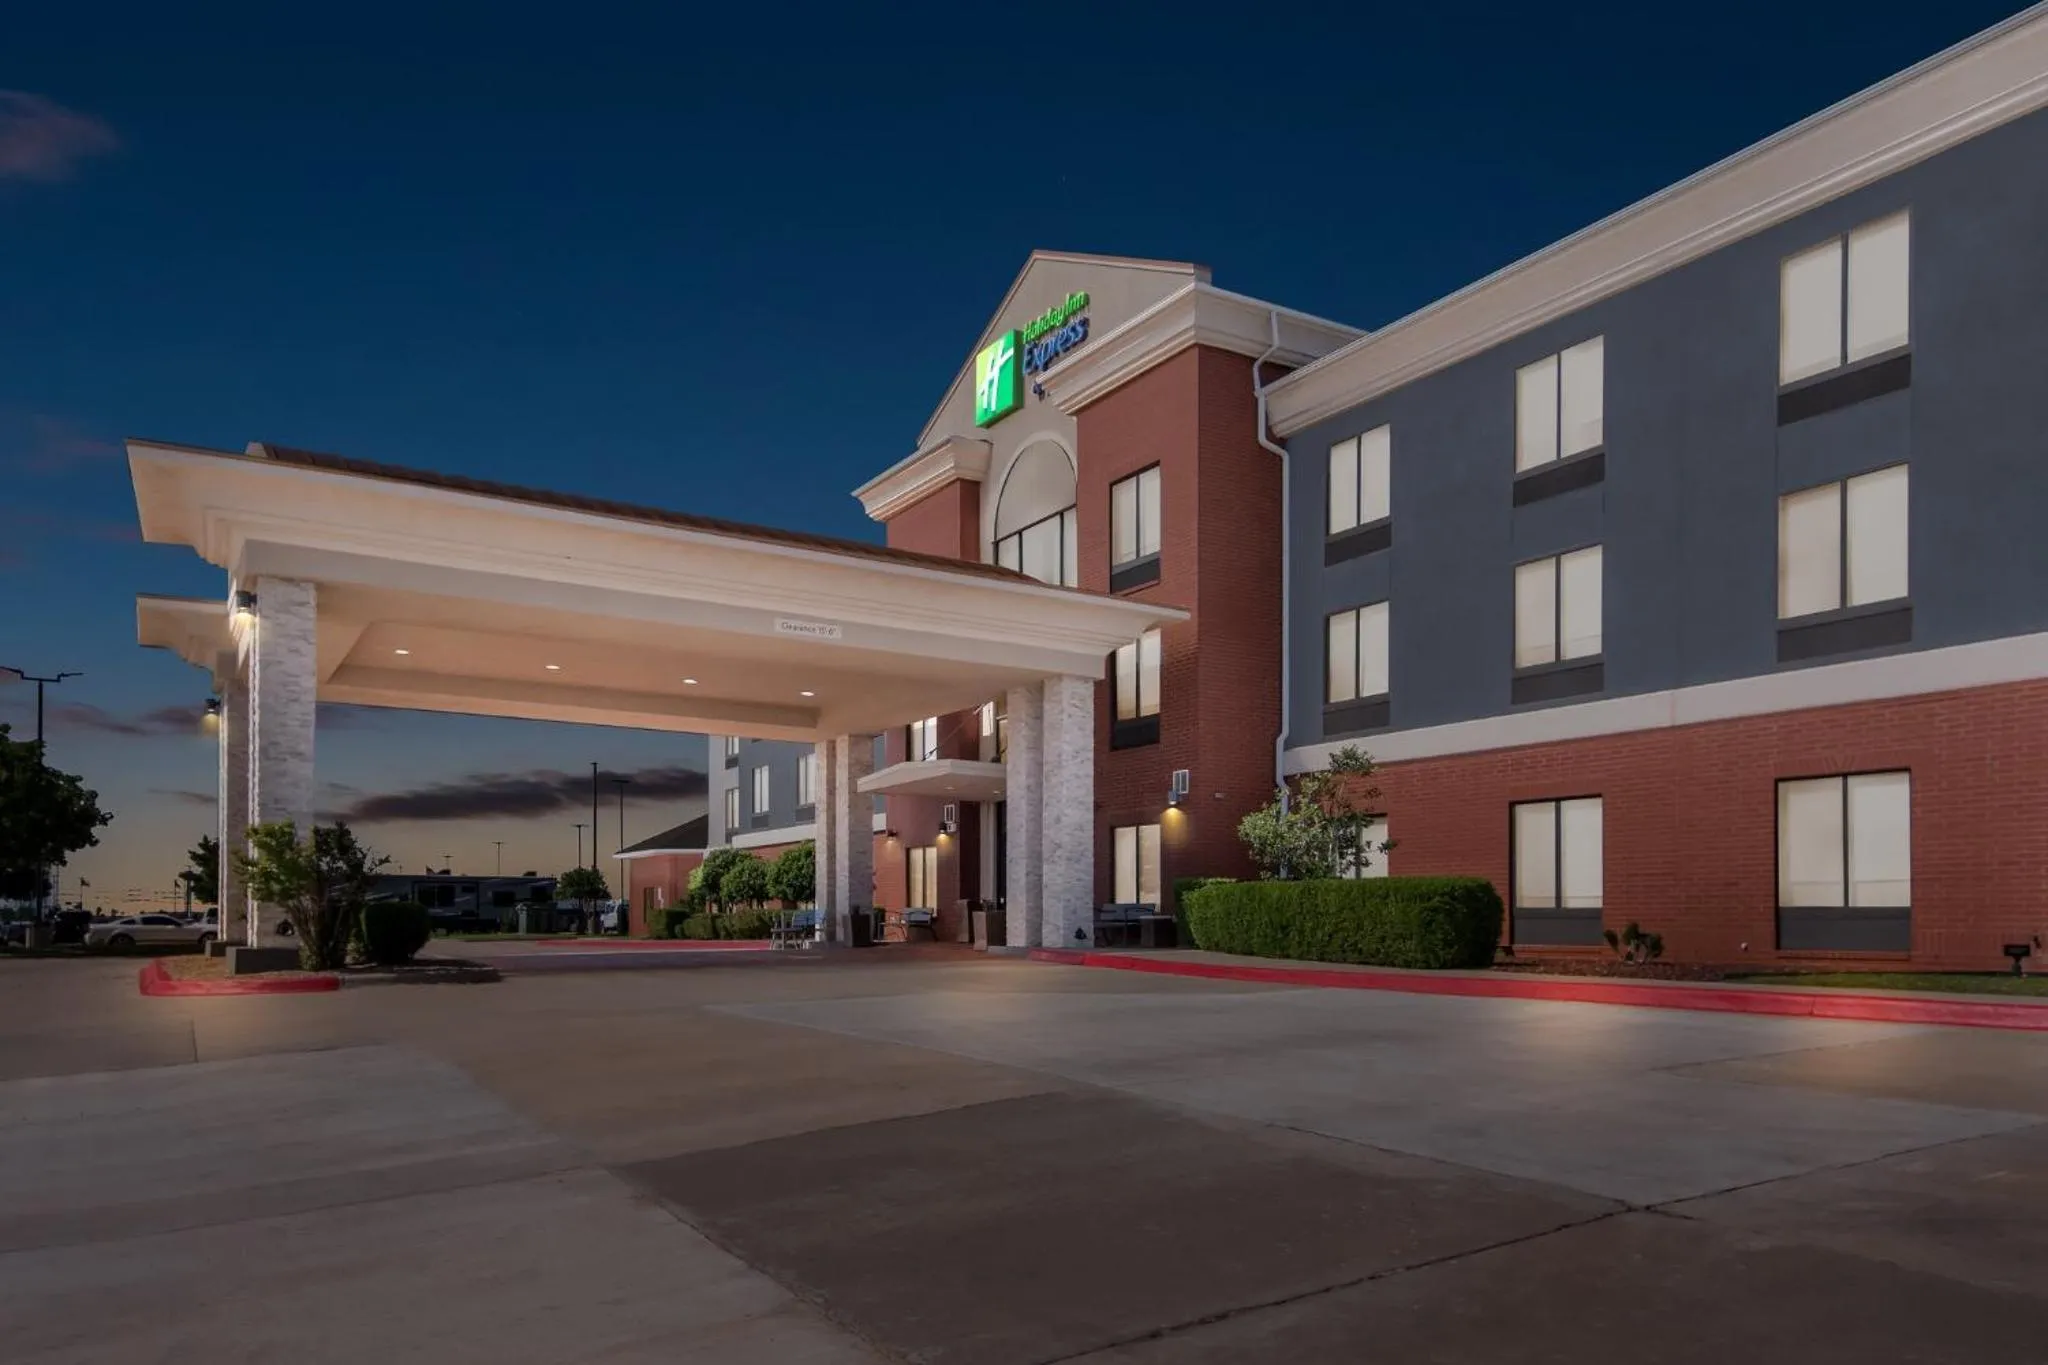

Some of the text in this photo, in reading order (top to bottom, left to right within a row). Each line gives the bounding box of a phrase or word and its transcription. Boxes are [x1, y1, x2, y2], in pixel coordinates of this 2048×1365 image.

[1023, 291, 1087, 344] Holiday Inn
[1023, 317, 1088, 376] Express
